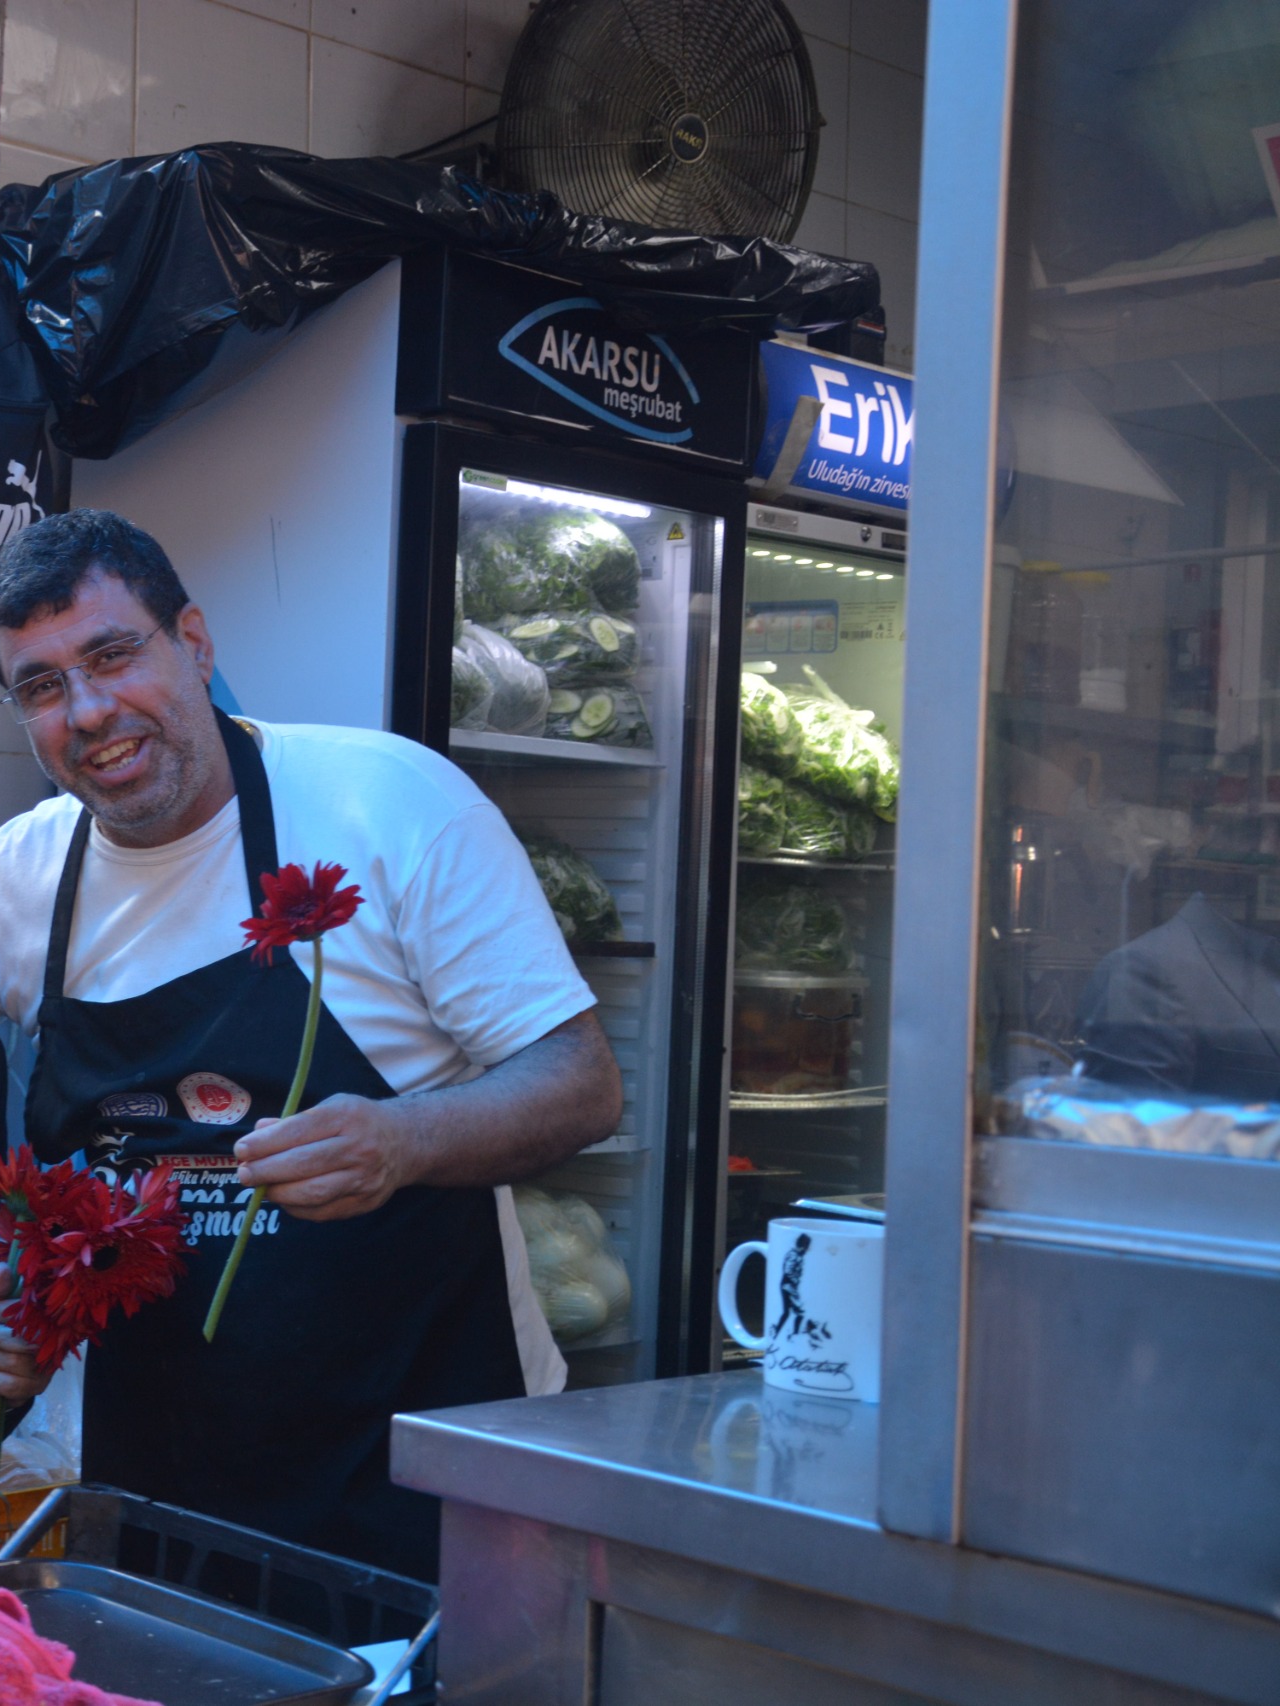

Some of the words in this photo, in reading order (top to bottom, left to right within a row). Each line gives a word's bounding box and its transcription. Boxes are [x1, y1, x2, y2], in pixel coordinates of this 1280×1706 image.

[538, 326, 660, 393] AKARSU
[604, 385, 682, 423] meşrubat
[810, 364, 915, 466] Erik
[180, 1209, 280, 1246] şması
